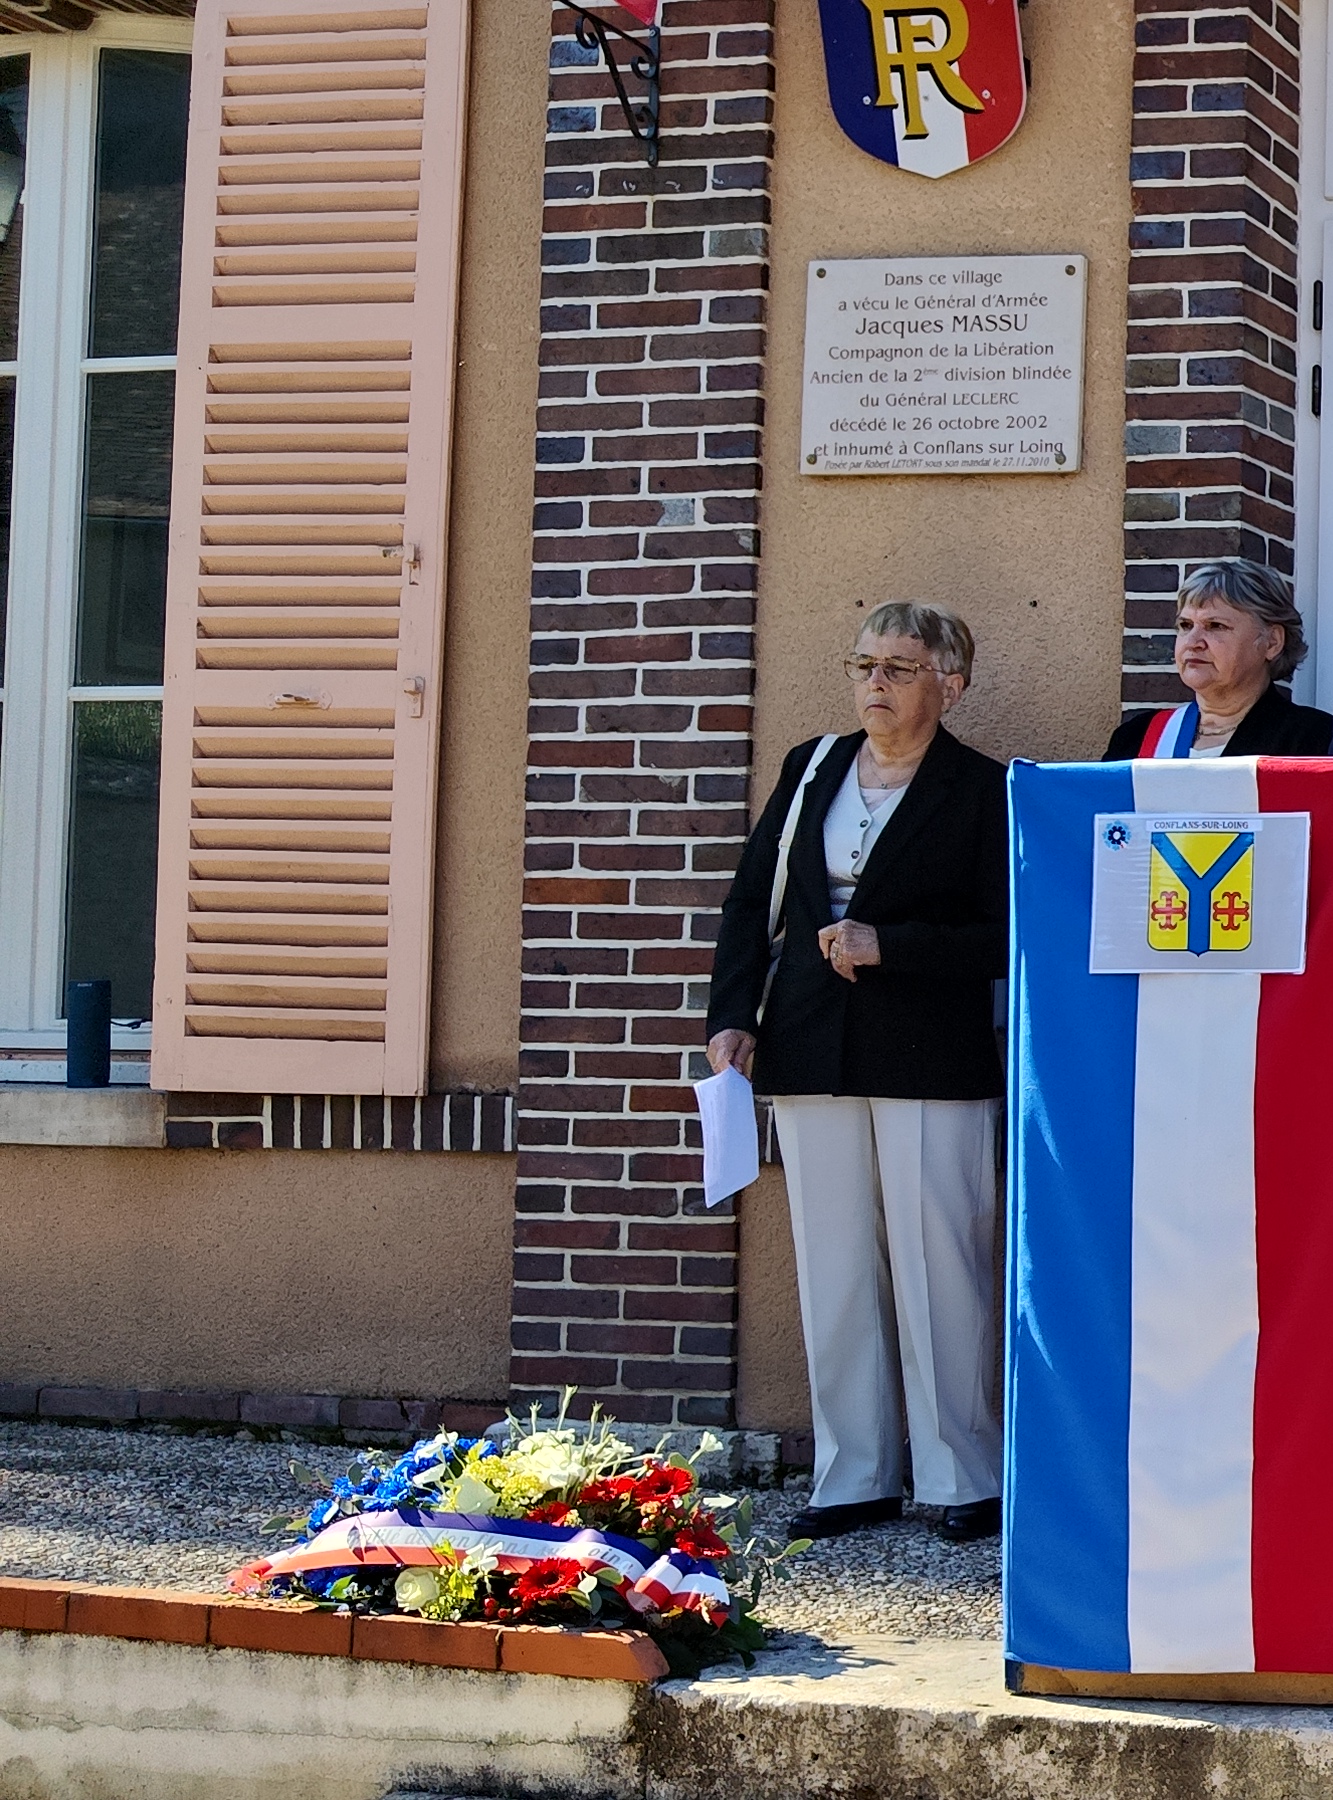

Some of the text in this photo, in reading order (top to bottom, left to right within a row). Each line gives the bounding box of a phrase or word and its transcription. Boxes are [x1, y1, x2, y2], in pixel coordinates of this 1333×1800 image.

[884, 270, 1002, 286] Dans ce village
[838, 301, 847, 311] a
[854, 297, 889, 310] vécu
[895, 296, 909, 310] le
[914, 294, 975, 309] Général
[855, 314, 1028, 338] Jacques MASSU
[829, 343, 1054, 362] Compagnon de la Libération
[810, 370, 863, 384] Ancien
[869, 370, 889, 383] de
[894, 369, 908, 382] la
[944, 367, 1006, 381] division
[1012, 366, 1072, 379] blindée
[860, 393, 1019, 407] du Général LECLERC
[830, 416, 1047, 432] décédé le 26 octobre 2002
[814, 440, 1064, 458] et inhumé à Conflans sur Loing
[1154, 821, 1249, 829] CONFLANS-SUR-LOING
